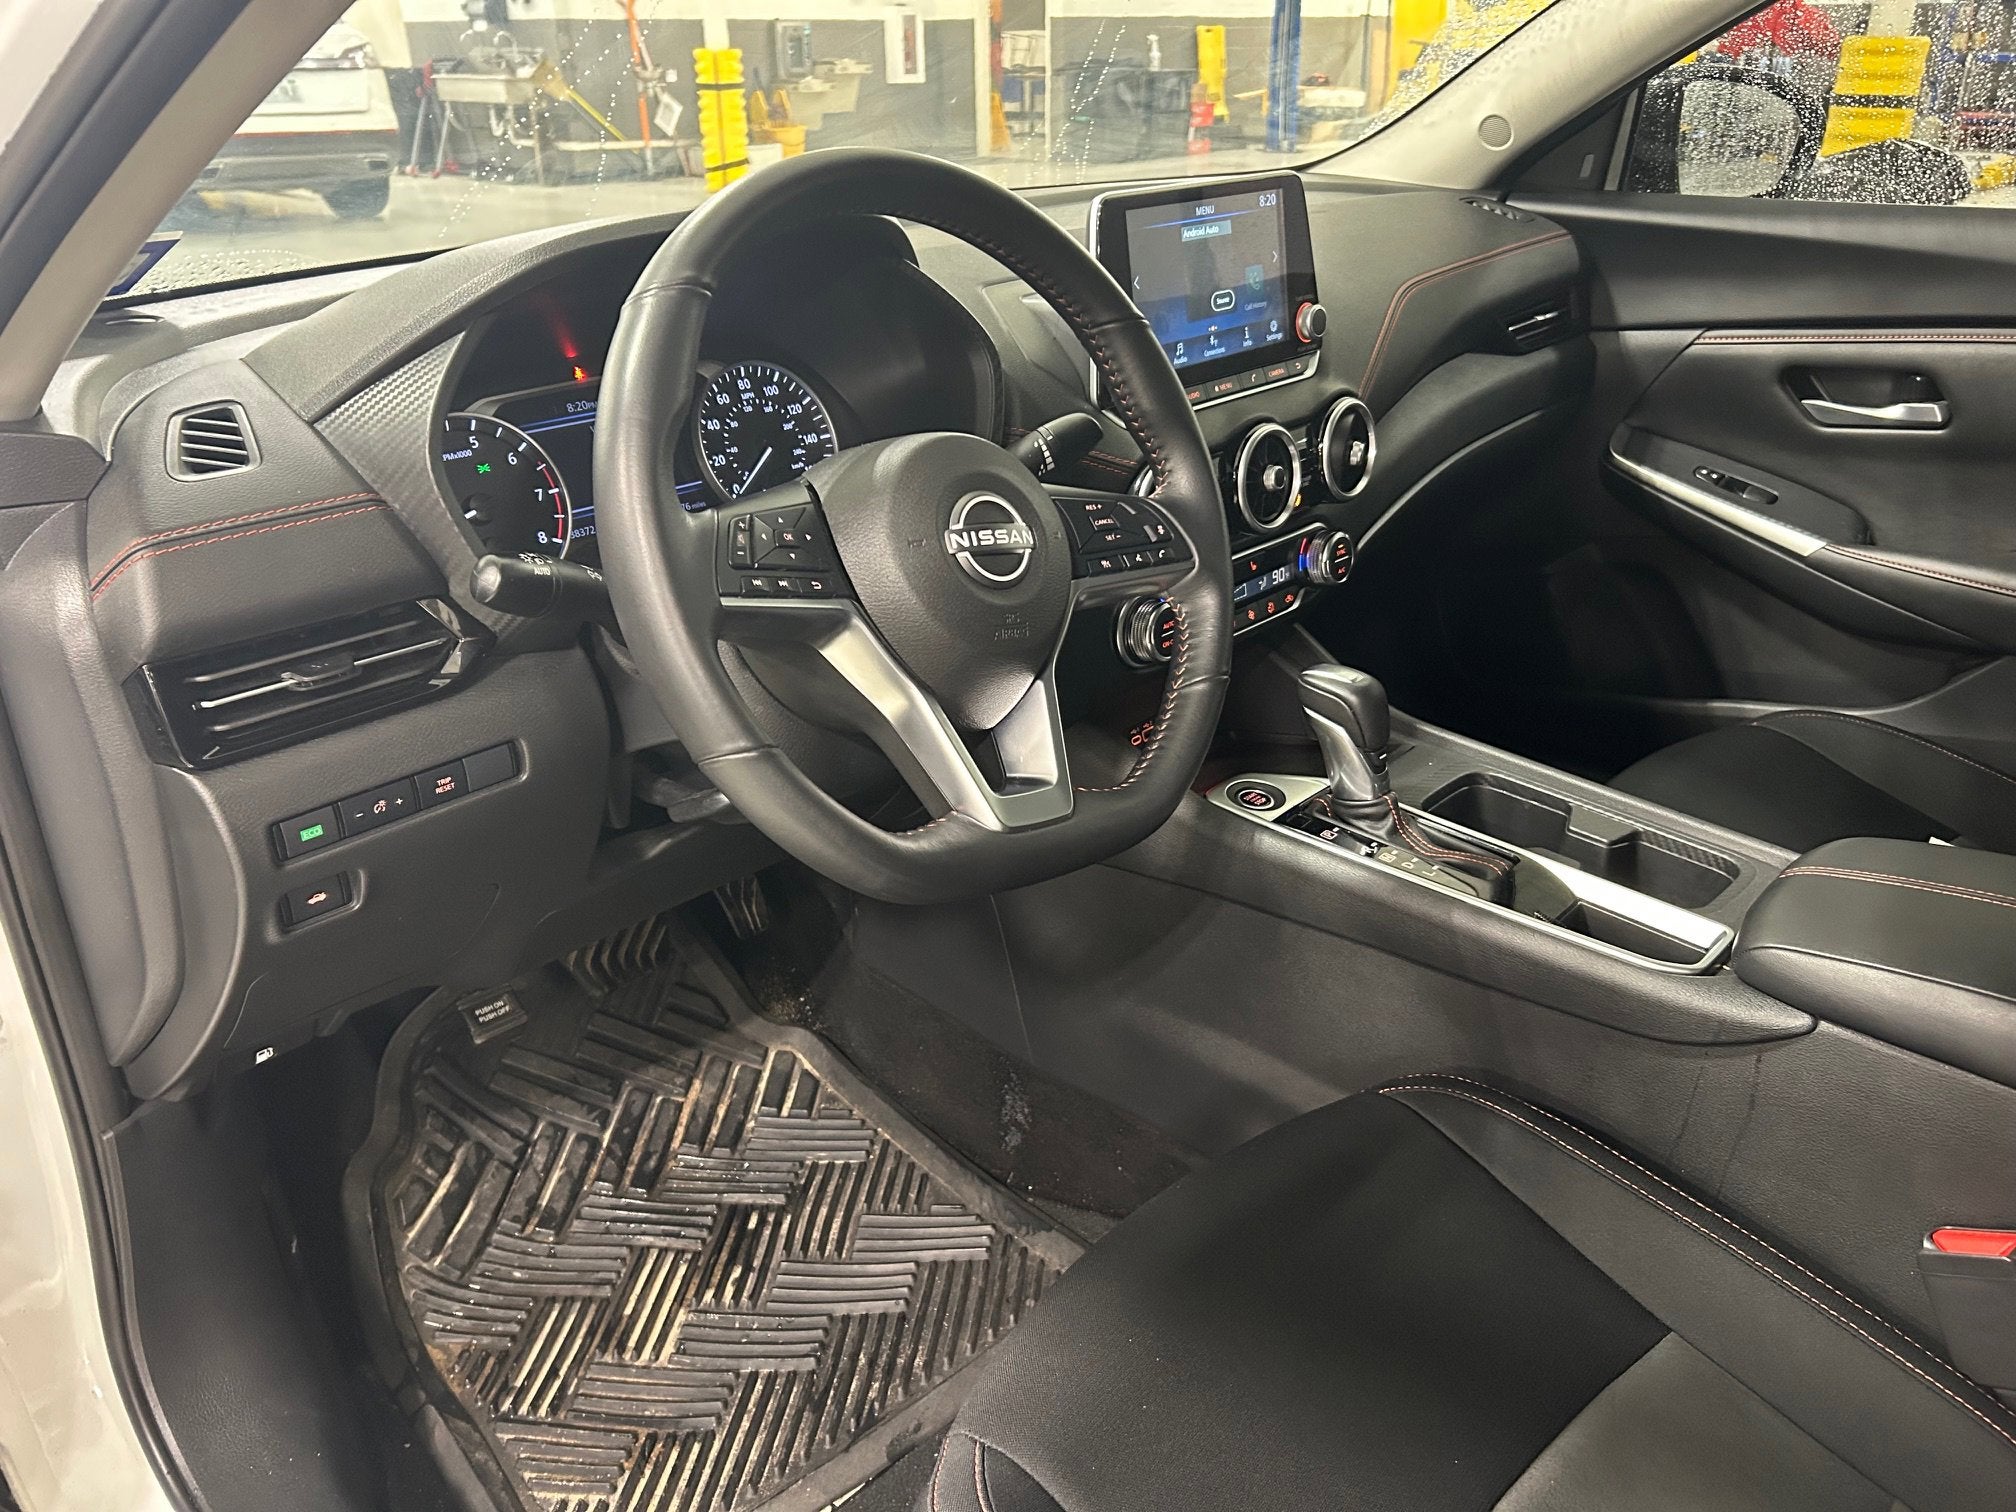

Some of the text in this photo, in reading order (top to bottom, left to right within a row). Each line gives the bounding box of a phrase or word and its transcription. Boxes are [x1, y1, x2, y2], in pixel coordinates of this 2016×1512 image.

[1258, 193, 1277, 207] 8:20
[1195, 205, 1215, 216] MENU
[1182, 225, 1219, 239] Android Auto
[737, 378, 751, 390] 80
[762, 384, 779, 397] 100
[716, 393, 730, 405] 60
[740, 392, 755, 400] MPH
[786, 404, 803, 415] 120
[706, 418, 721, 431] 40
[468, 435, 480, 449] 5
[802, 434, 819, 446] 140
[507, 452, 518, 465] 6
[712, 454, 727, 467] 20
[534, 488, 544, 502] 7
[1094, 518, 1115, 526] CANCEL
[536, 530, 548, 544] 8
[950, 528, 1034, 549] NISSAN
[1272, 567, 1285, 585] 90
[436, 776, 452, 786] TRIP
[435, 782, 456, 795] RESET
[303, 828, 322, 840] ECO
[475, 1000, 504, 1016] PUSH ON
[478, 1005, 510, 1023] PUSH OFF
